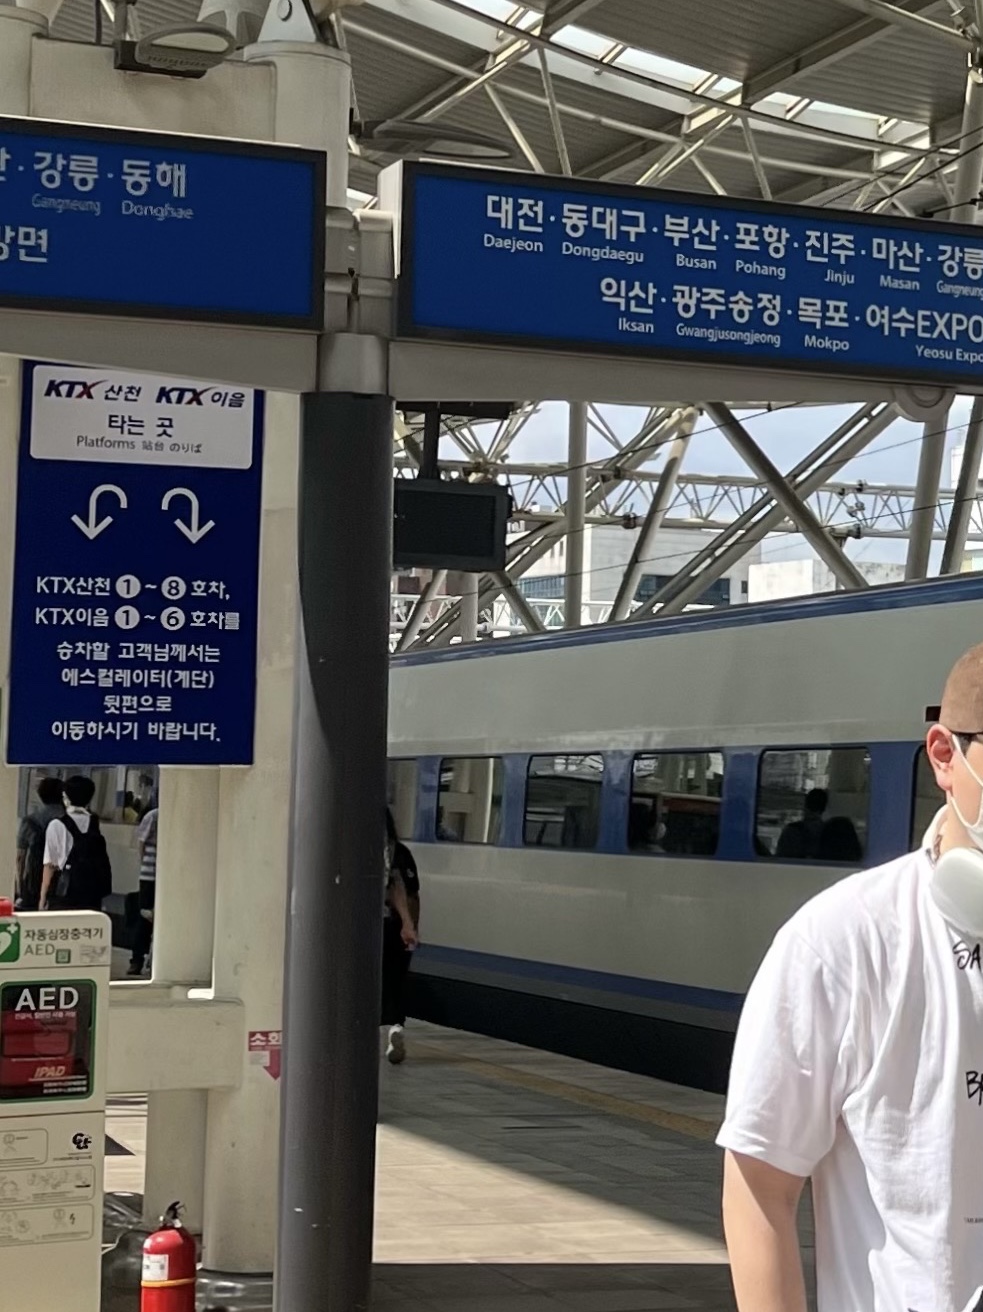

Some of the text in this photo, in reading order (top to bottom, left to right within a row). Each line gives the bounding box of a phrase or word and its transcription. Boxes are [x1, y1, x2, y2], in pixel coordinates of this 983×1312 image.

[33, 151, 99, 192] 강릉
[121, 158, 187, 198] 동해
[121, 200, 194, 221] Donghae
[486, 194, 544, 233] 대전
[561, 202, 647, 242] 동대구
[663, 213, 720, 251] 부산
[734, 221, 791, 259] 포항
[805, 229, 855, 265] 진주
[872, 237, 924, 273] 마산
[483, 233, 544, 253] Daejeon
[561, 242, 644, 264] Dongdaegu
[676, 254, 717, 271] Busan
[735, 259, 786, 280] Pohang
[824, 269, 855, 286] Jinju
[879, 274, 920, 291] Masan
[600, 277, 657, 314] 익산
[672, 284, 782, 327] 광주송정
[798, 297, 849, 330] 목포
[618, 317, 654, 334] Iksan
[676, 323, 781, 348] Gwangjusongjeong
[804, 334, 850, 352] Mokpo
[915, 344, 953, 361] Yeosu
[44, 379, 246, 408] KTX 산천 KTX 이음
[108, 414, 174, 438] 타는 곳
[76, 435, 136, 450] Platforms
[36, 576, 111, 596] KTX산천
[35, 606, 109, 627] KTX이음
[190, 611, 240, 630] 호차를
[56, 641, 221, 662] 승차할 고객님께서는
[61, 668, 215, 689] 에스컬레이터(계단)
[103, 695, 172, 714] 뒷편으로
[51, 721, 221, 742] 이동하시기 바랍니다.
[24, 927, 103, 942] 자동심장충격기
[24, 944, 55, 956] AED
[15, 986, 79, 1011] AED
